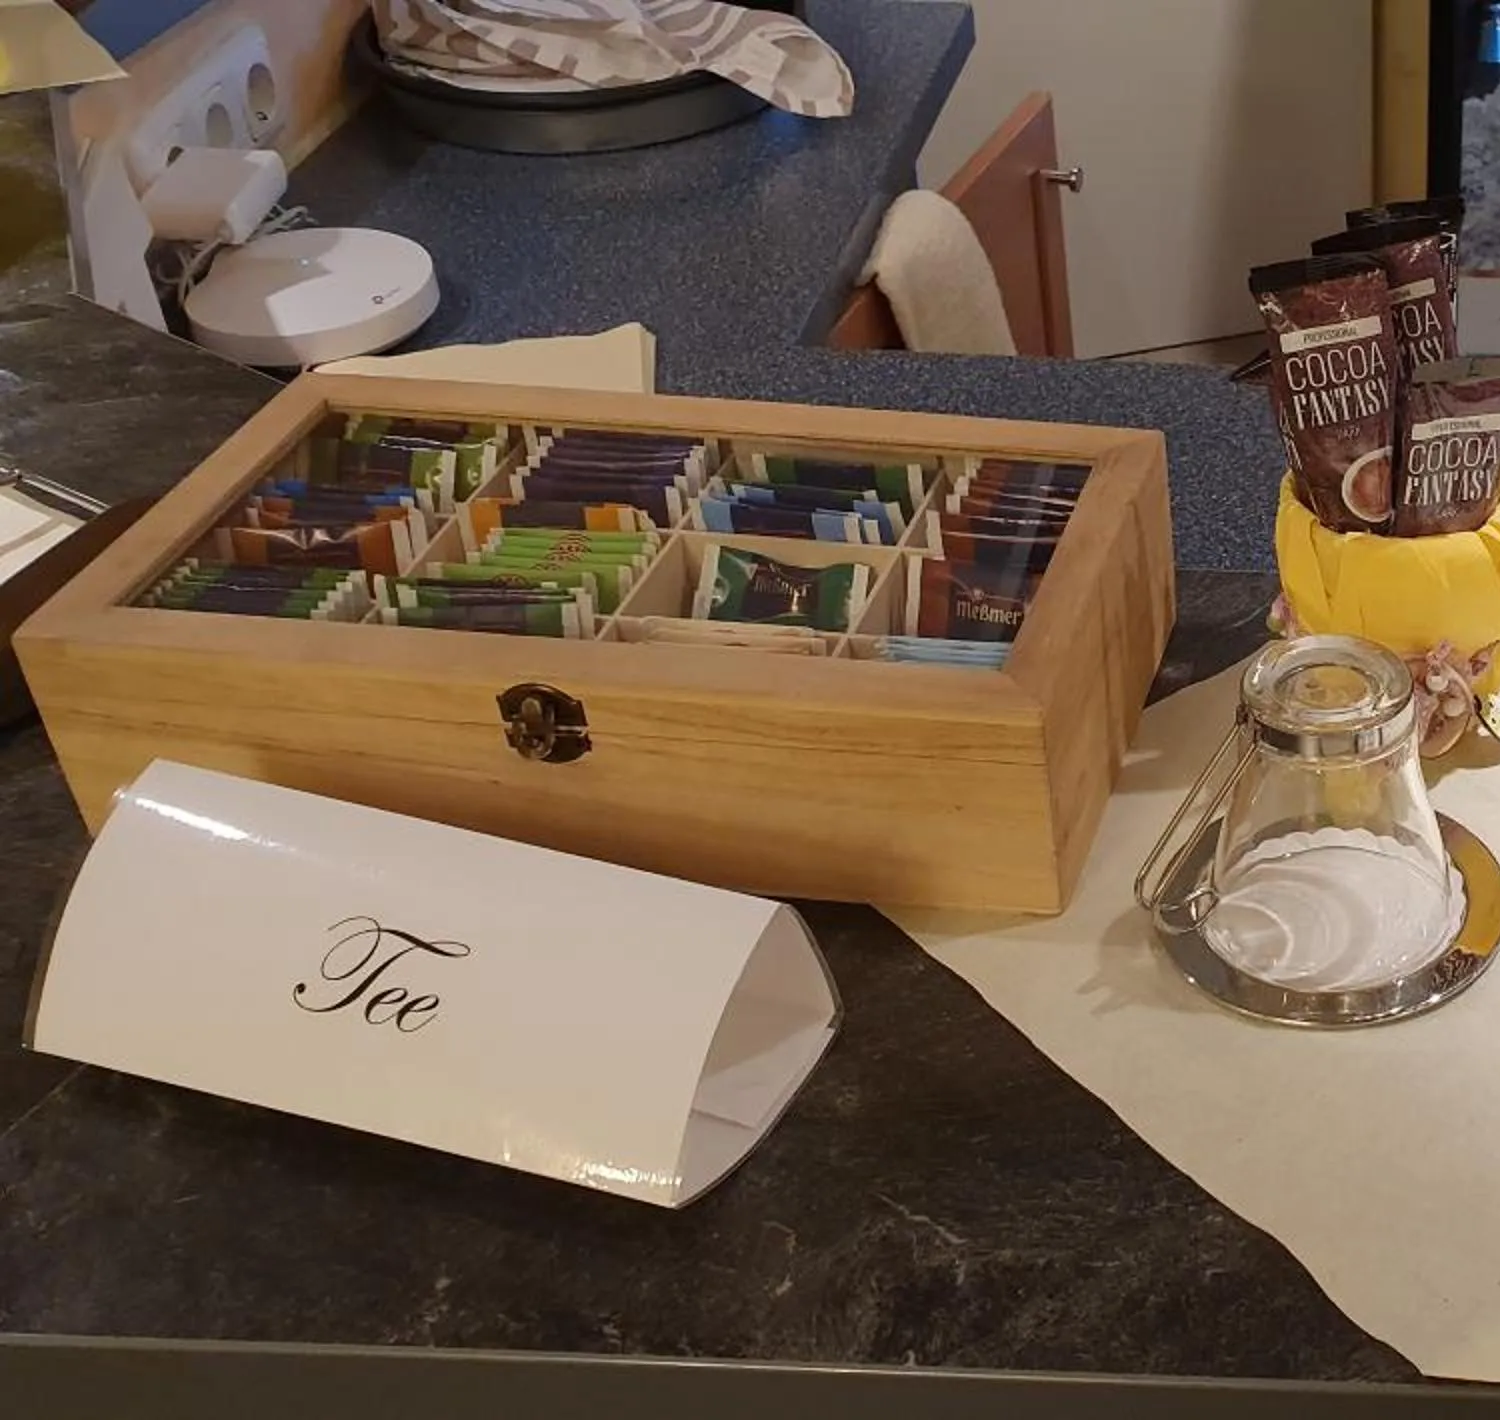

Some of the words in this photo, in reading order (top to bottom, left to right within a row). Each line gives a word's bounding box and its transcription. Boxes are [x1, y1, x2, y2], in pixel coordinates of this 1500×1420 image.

[1286, 341, 1387, 391] COCOA
[1293, 374, 1389, 431] FANTASY
[1408, 436, 1498, 475] COCOA
[1404, 469, 1497, 506] FANTASY
[294, 915, 470, 1032] Tee
